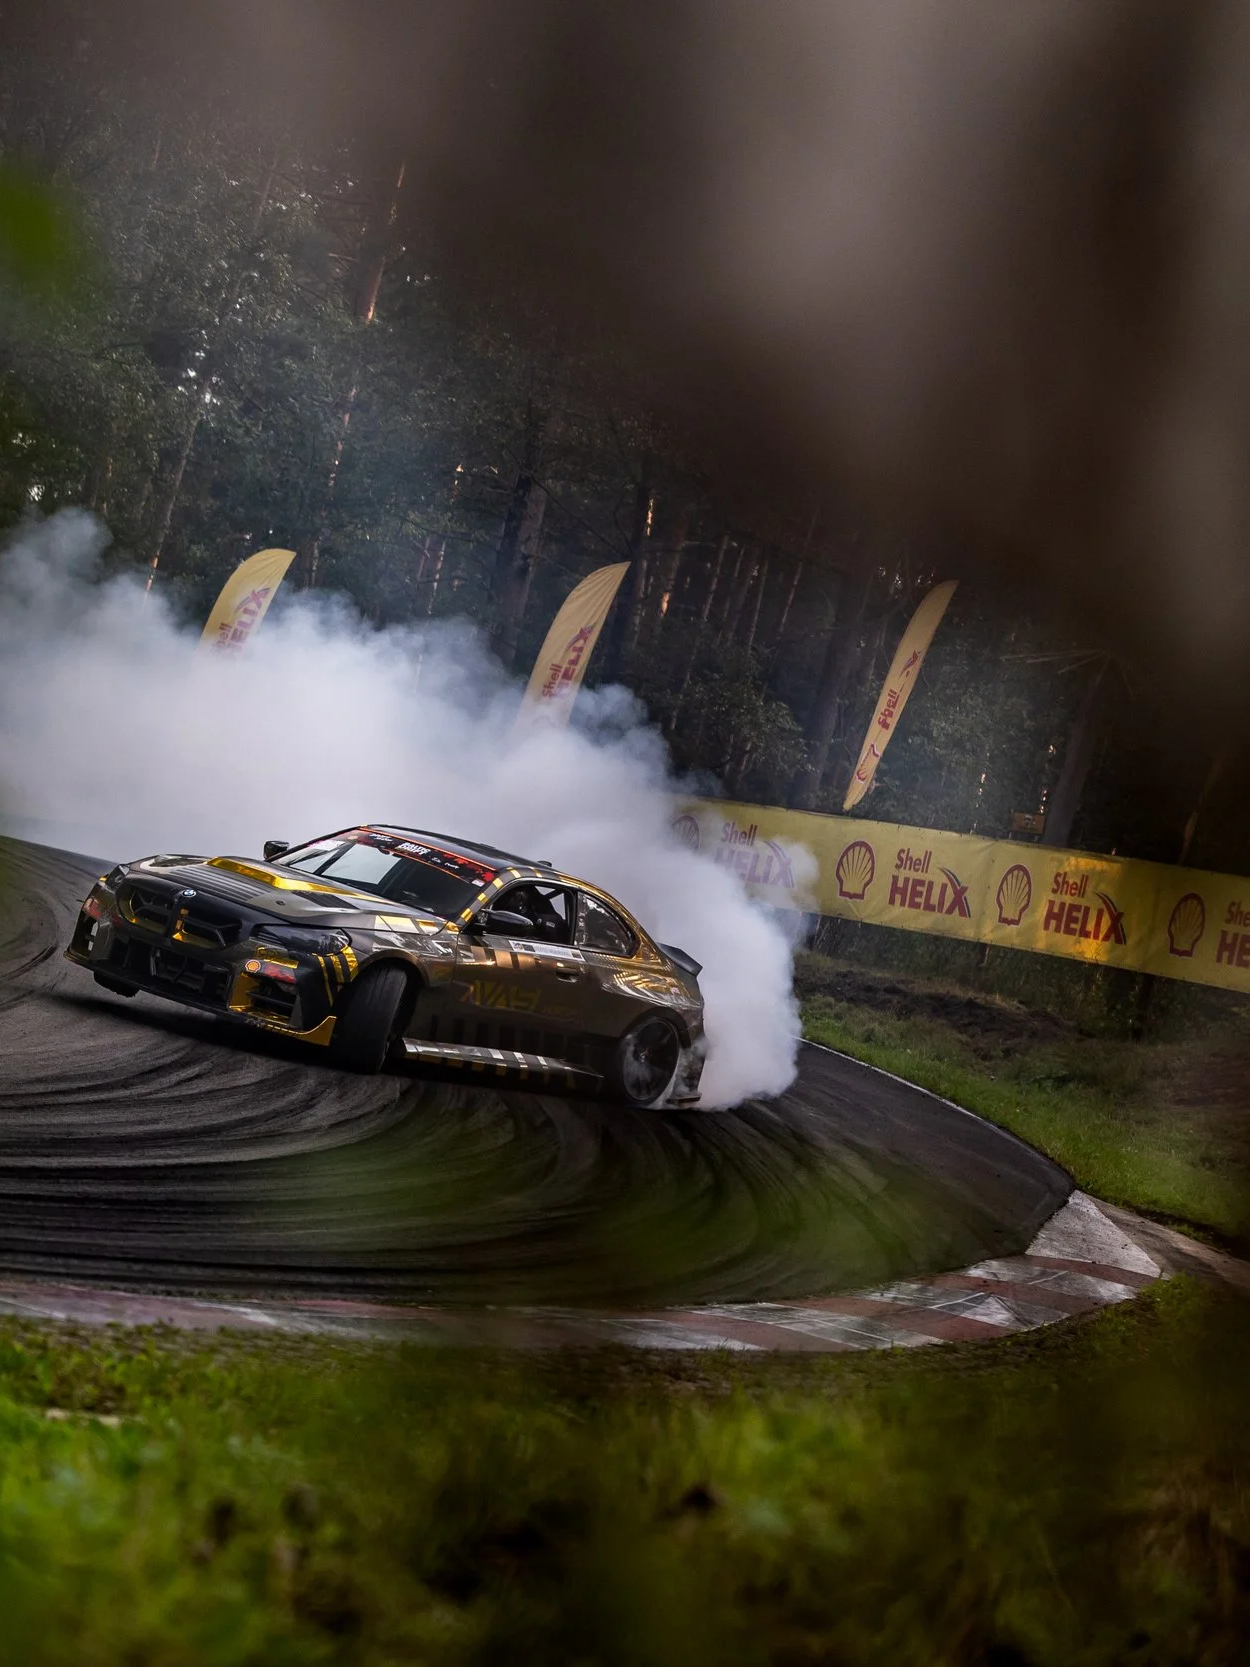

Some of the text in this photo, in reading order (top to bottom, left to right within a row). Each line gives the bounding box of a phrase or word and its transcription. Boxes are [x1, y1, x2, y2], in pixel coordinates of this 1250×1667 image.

[542, 664, 563, 698] Shell
[721, 821, 758, 846] Shell
[895, 848, 932, 874] Shell
[888, 867, 971, 918] HELIX
[1051, 872, 1089, 898] Shell
[1043, 891, 1126, 945] HELIX
